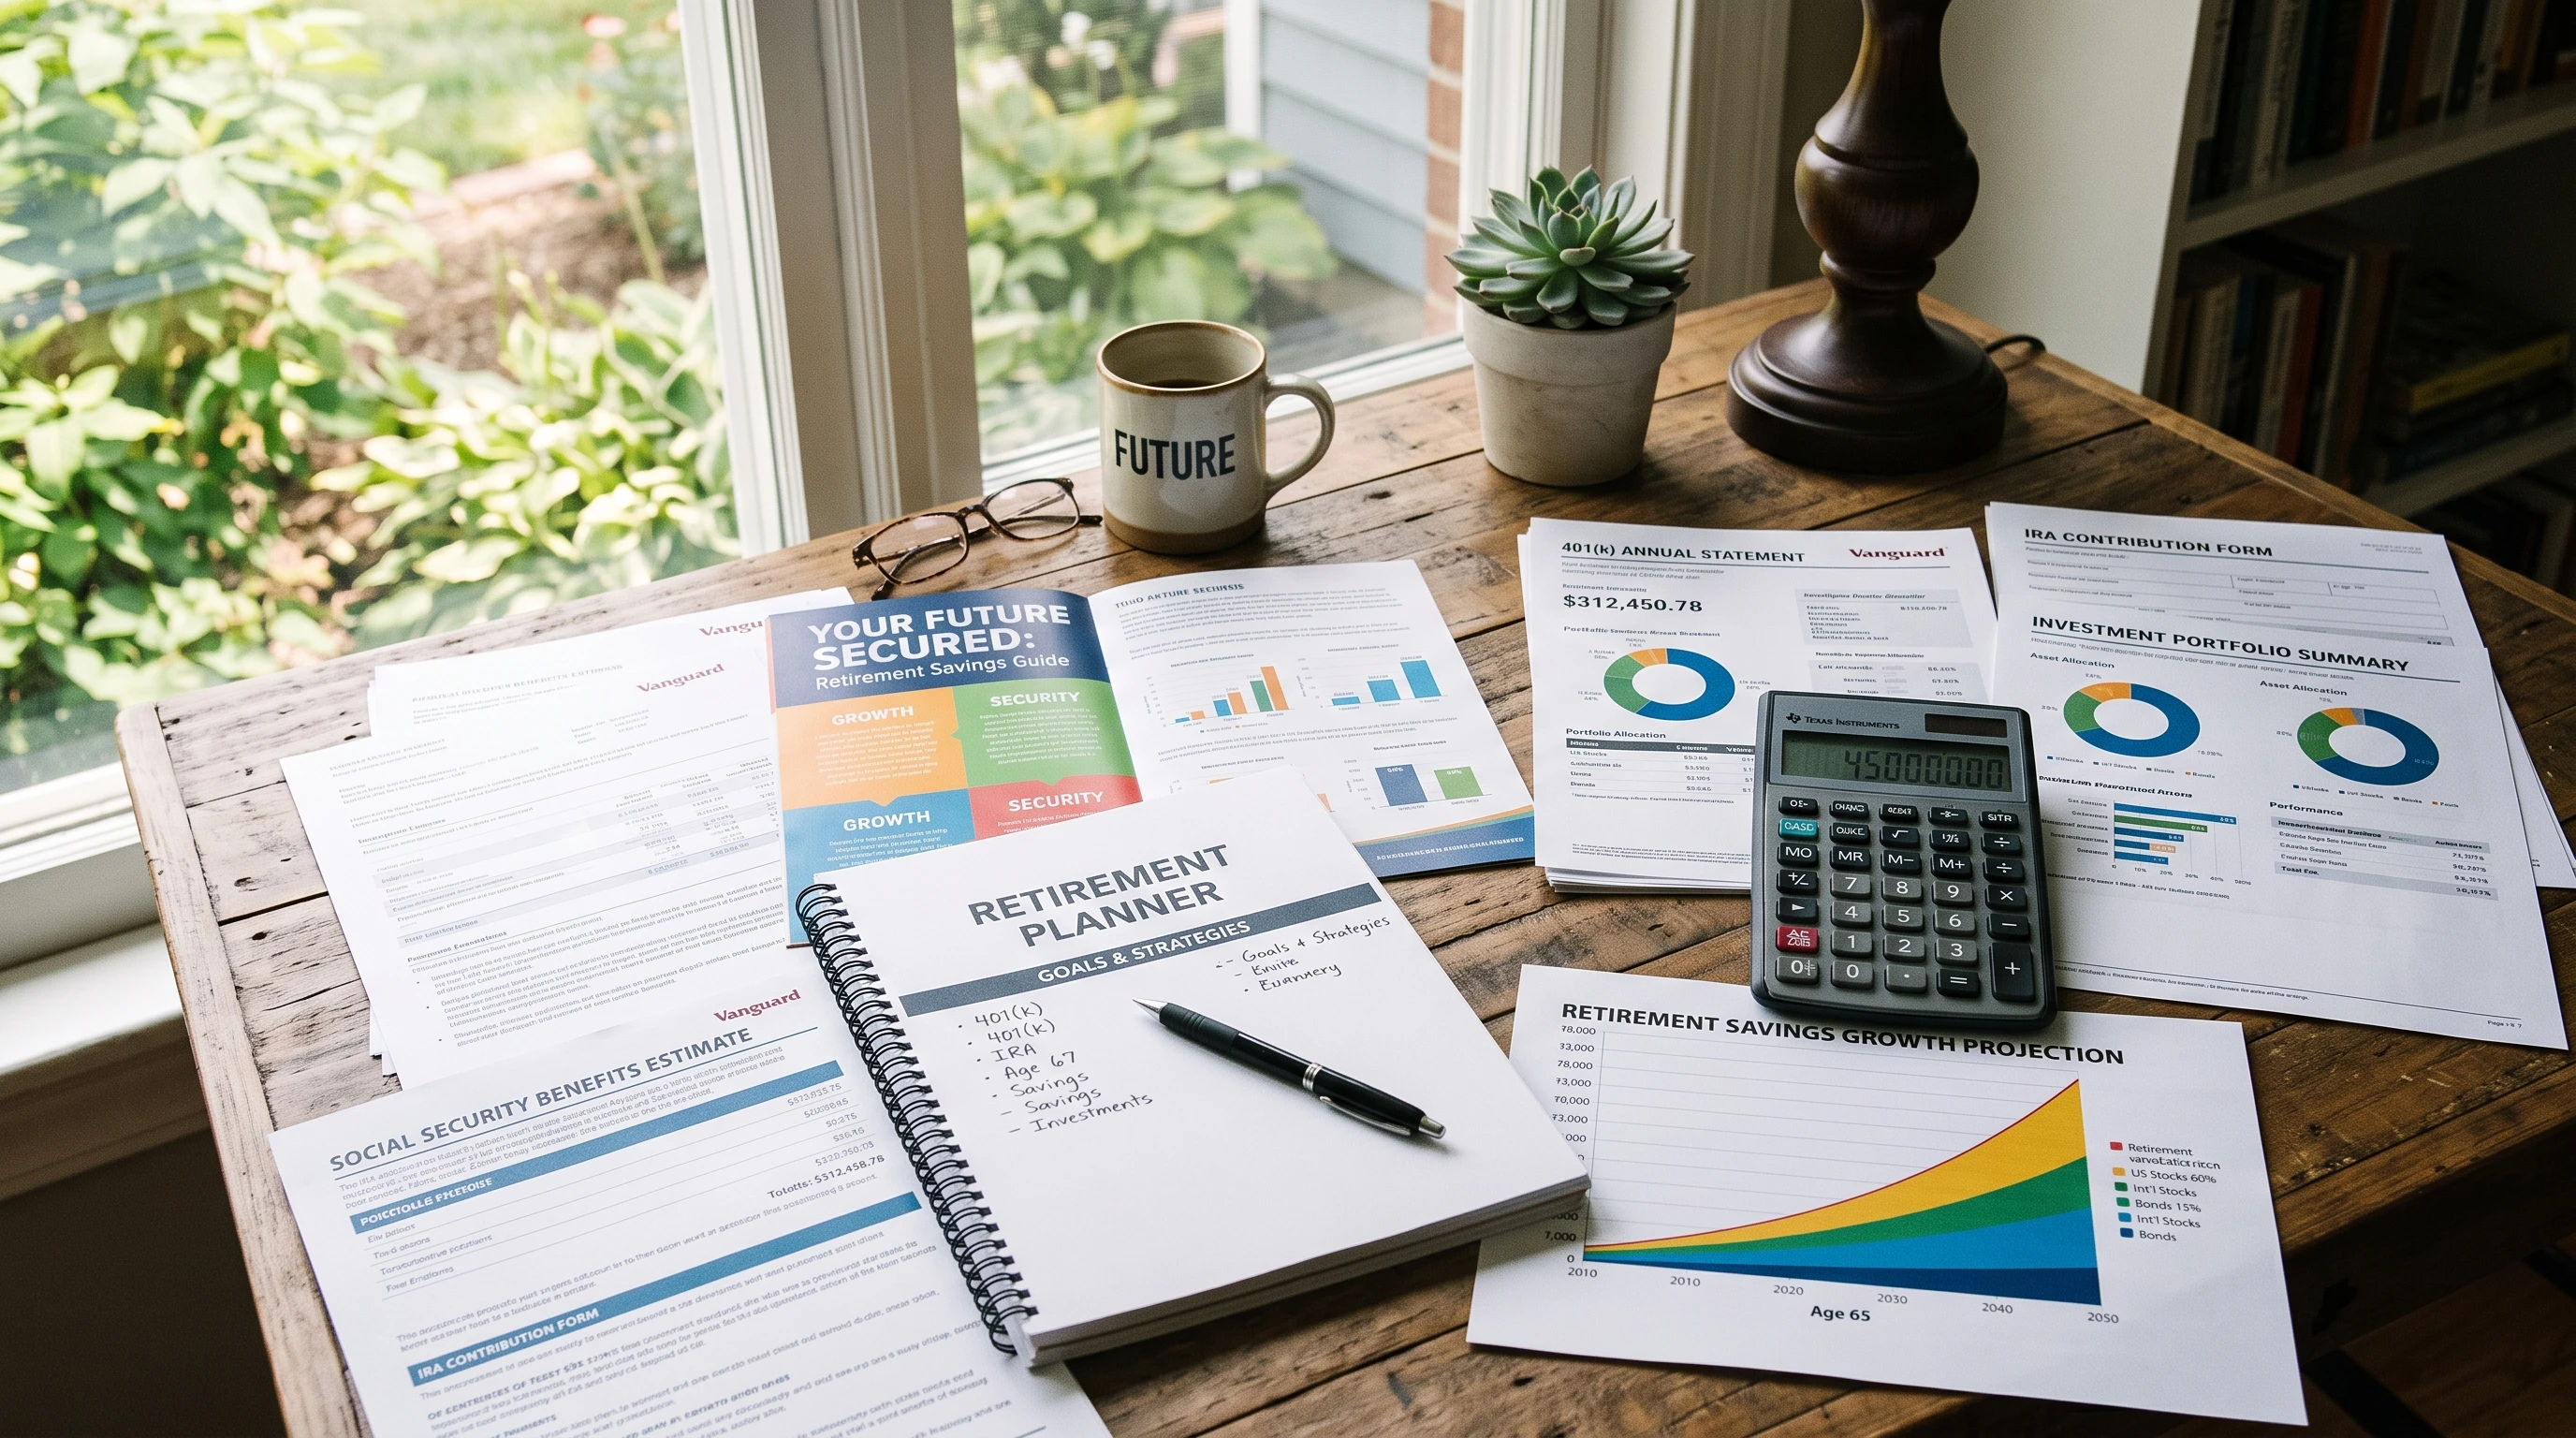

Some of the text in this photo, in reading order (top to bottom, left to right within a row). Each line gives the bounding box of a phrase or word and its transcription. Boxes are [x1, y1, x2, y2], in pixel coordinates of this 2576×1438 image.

[1115, 429, 1235, 480] FUTURE
[2025, 529, 2273, 556] IRA CONTRIBUTION FORM
[1561, 542, 1806, 563] 401(k) ANNUAL STATEMENT
[1849, 548, 1945, 560] Vanguard
[1563, 594, 1703, 612] $312,450.78
[808, 604, 1071, 643] YOUR FUTURE
[812, 627, 1034, 671] SECURED:
[2032, 616, 2166, 643] INVESTMENT
[2173, 635, 2291, 658] PORTFOLIO
[2298, 649, 2409, 672] SUMMARY
[2030, 653, 2115, 668] Asset Allocation
[637, 664, 724, 694] Vanguard
[815, 653, 1070, 691] Retirement Savings Guide
[2260, 681, 2348, 697] Asset Allocation
[989, 692, 1080, 708] SECURITY
[831, 705, 915, 726] GROWTH
[1566, 727, 1666, 740] Portfolio Allocation
[1008, 791, 1104, 813] SECURITY
[843, 810, 930, 831] GROWTH
[1838, 852, 1863, 862] MR
[1939, 858, 1965, 869] M+
[968, 844, 1230, 926] RETIREMENT
[1845, 877, 1857, 890] 7
[1896, 882, 1908, 895] 8
[1947, 886, 1959, 898] 9
[1018, 880, 1224, 947] PLANNER
[1845, 905, 1858, 918] 4
[1897, 910, 1910, 923] 5
[1949, 914, 1961, 927] 6
[1242, 944, 1290, 962] Goals
[1312, 917, 1390, 944] Strategies
[1848, 935, 1856, 948] 1
[1899, 940, 1910, 953] 2
[1037, 920, 1251, 983] GOALS & STRATEGIES
[1951, 944, 1963, 957] 3
[1846, 964, 1858, 977] 0
[714, 989, 801, 1022] Vanguard
[1561, 1003, 2125, 1064] RETIREMENT SAVINGS GROWTH PROJECTION
[990, 1043, 1036, 1063] IRA
[1004, 1051, 1075, 1080] Age 67
[1010, 1072, 1089, 1096] Savings
[329, 1027, 754, 1171] SOCIAL SECURITY BENEFITS ESTIMATE
[1025, 1087, 1102, 1114] Savings
[1030, 1094, 1153, 1132] Investments
[2128, 1143, 2193, 1156] Retirement
[2131, 1169, 2217, 1183] US Stocks 60%
[2133, 1184, 2197, 1197] Int'l Stocks
[2135, 1199, 2173, 1211] Bonds
[2137, 1215, 2201, 1228] Int'l Stocks
[1545, 1231, 1576, 1241] 7,000
[2140, 1230, 2176, 1241] Bonds
[1567, 1255, 1574, 1263] 0
[1568, 1267, 1598, 1278] 2010
[1670, 1276, 1701, 1287] 2010
[1773, 1284, 1804, 1296] 2020
[1877, 1293, 1908, 1304] 2030
[1810, 1305, 1871, 1322] Age 65
[1982, 1302, 2013, 1314] 2040
[2087, 1312, 2119, 1324] 2050
[417, 1308, 600, 1380] IRA CONTRIBUTION FORM
